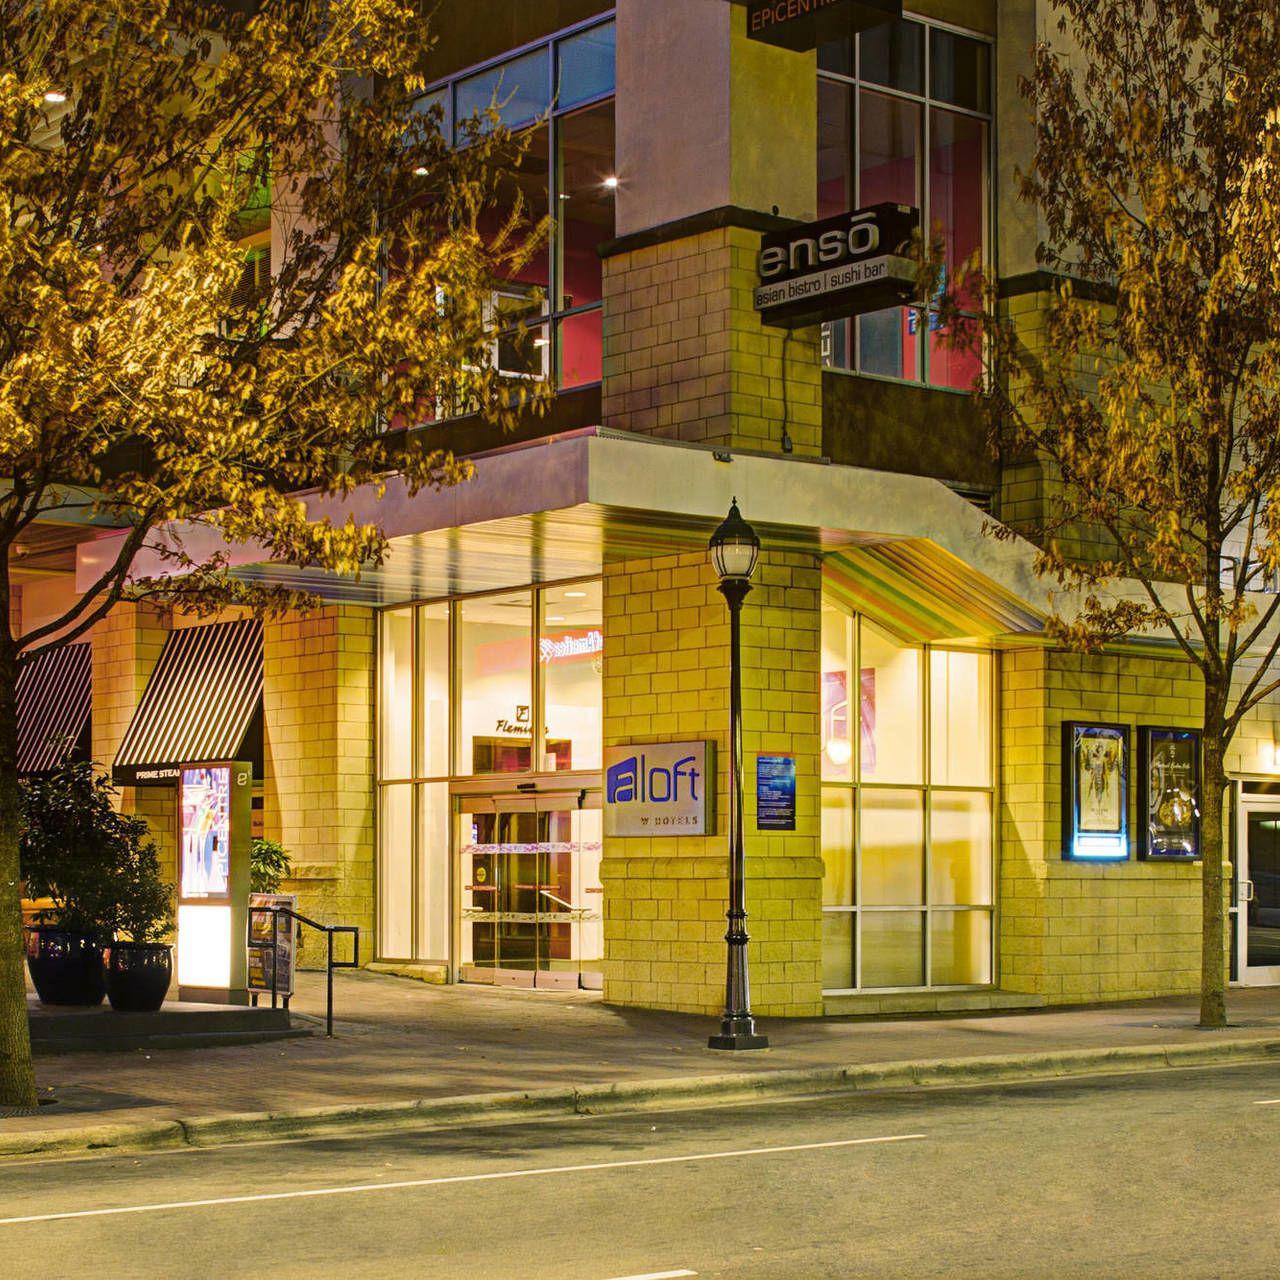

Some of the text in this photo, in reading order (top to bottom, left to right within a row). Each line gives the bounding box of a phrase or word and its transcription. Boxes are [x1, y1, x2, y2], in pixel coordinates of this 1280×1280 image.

[756, 261, 886, 306] asian bistro sushi bar
[136, 770, 159, 780] PRIME
[606, 754, 700, 804] aloft
